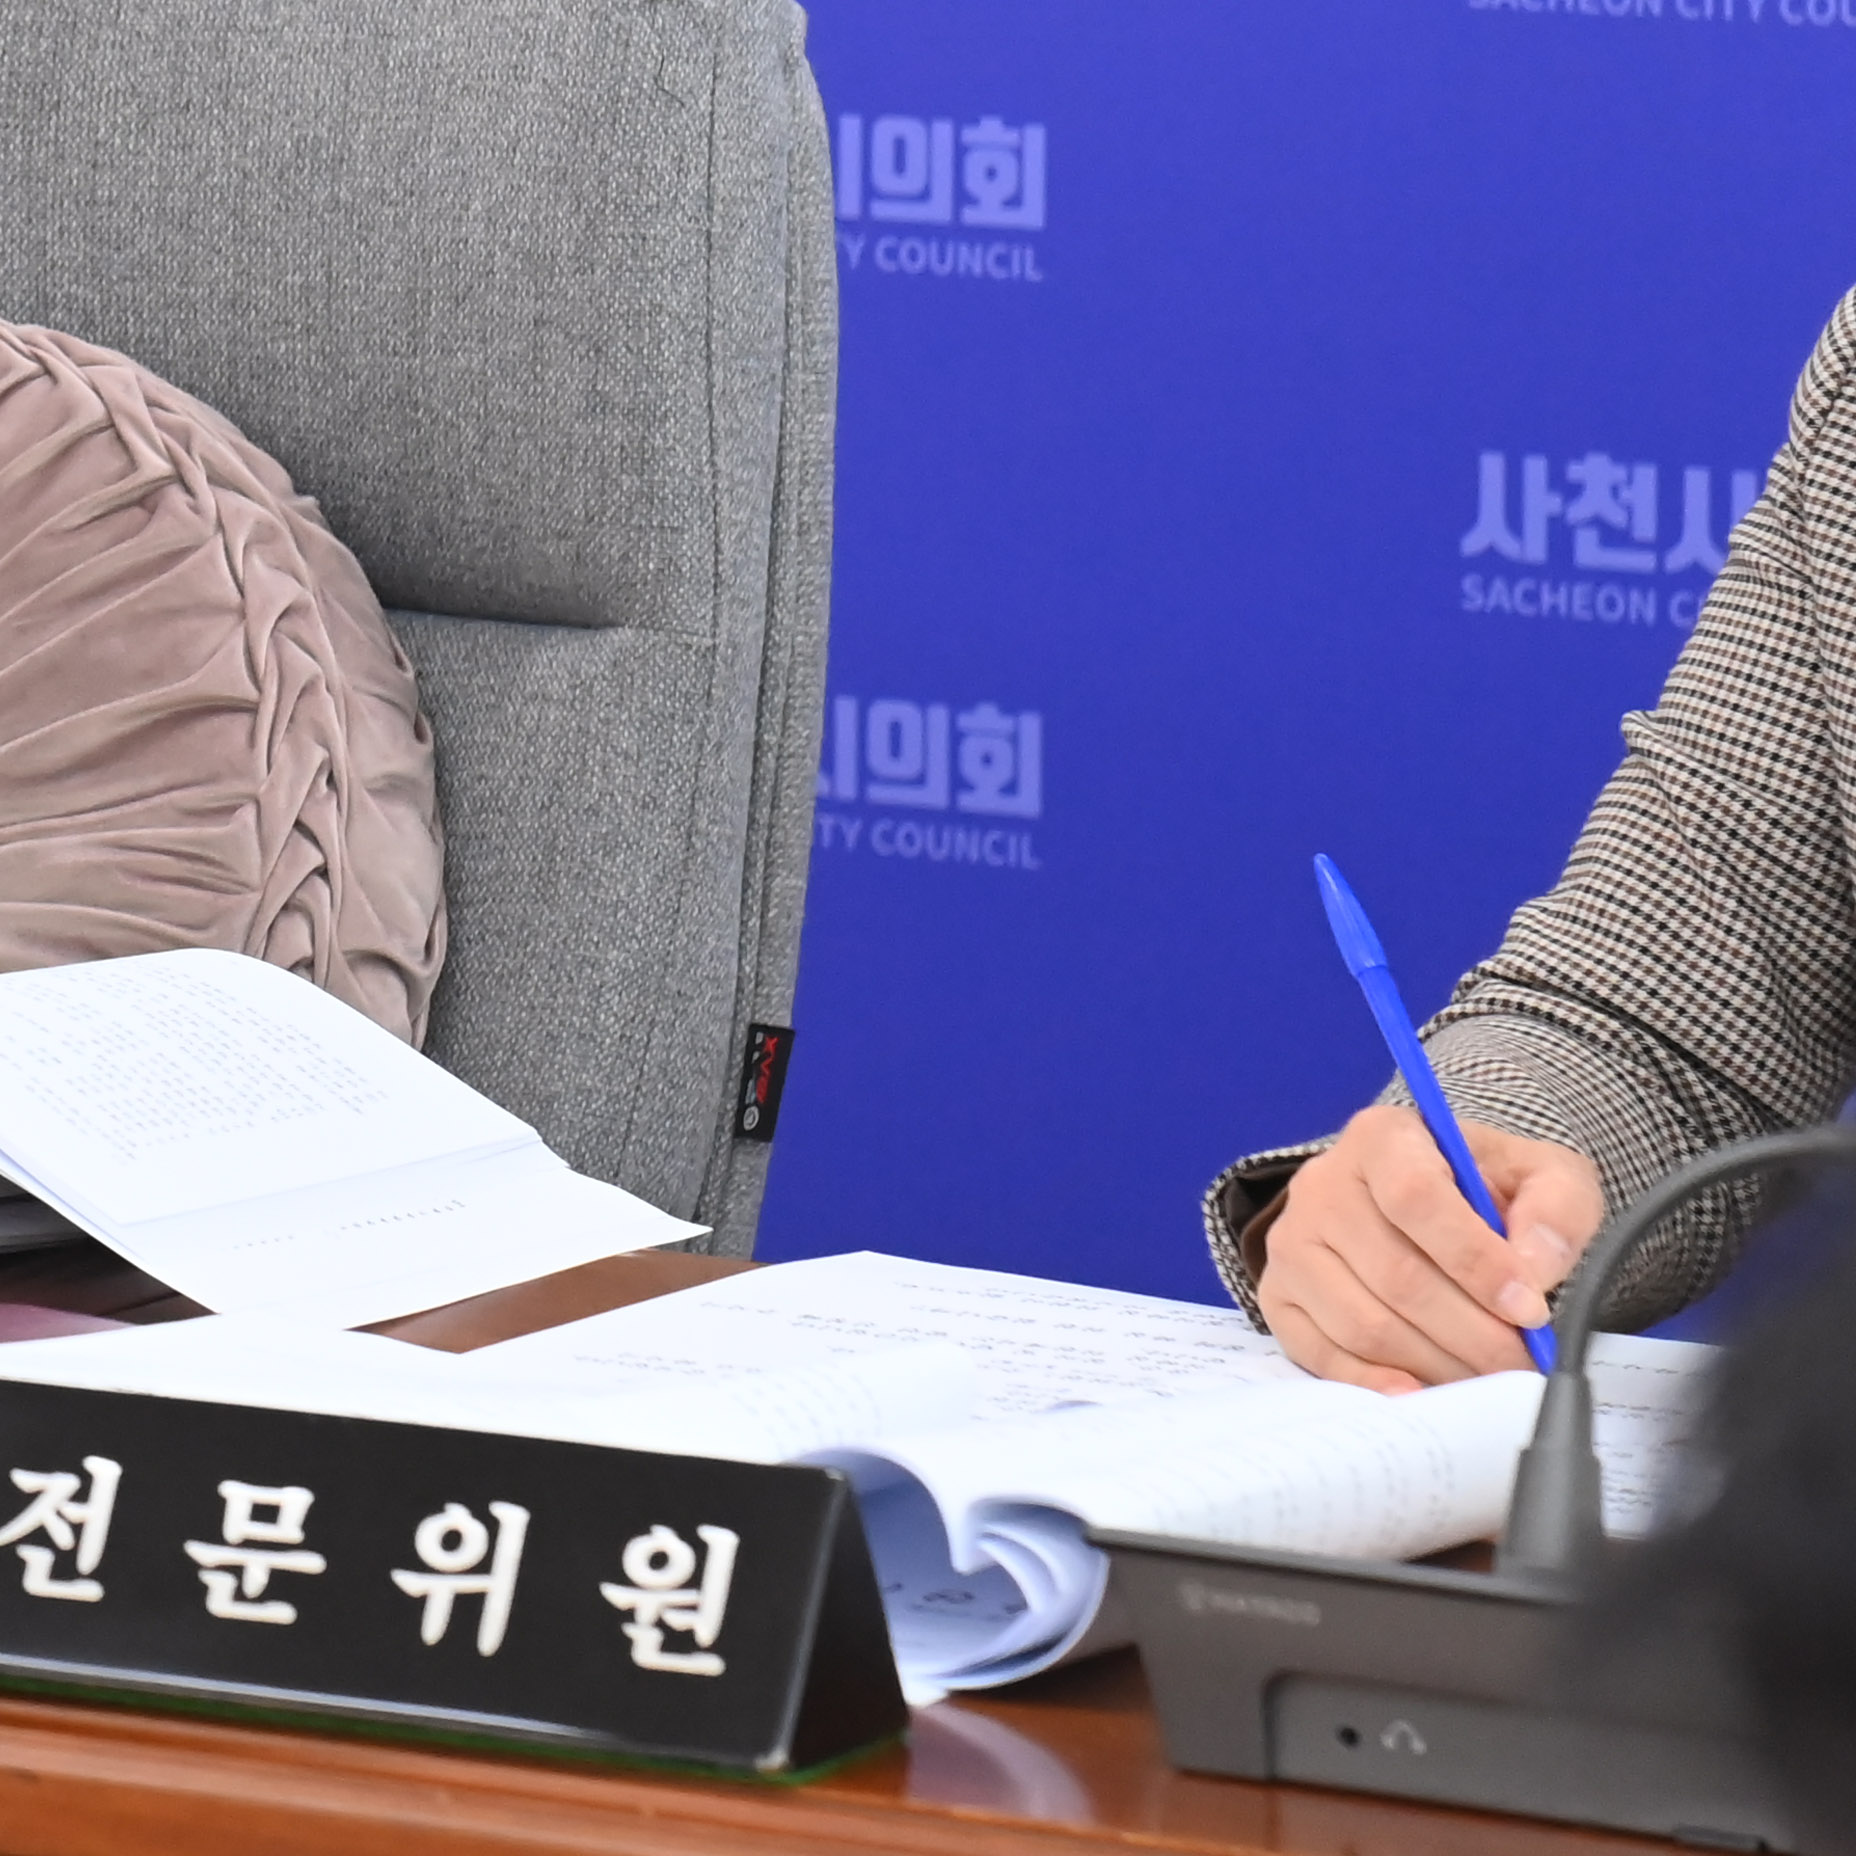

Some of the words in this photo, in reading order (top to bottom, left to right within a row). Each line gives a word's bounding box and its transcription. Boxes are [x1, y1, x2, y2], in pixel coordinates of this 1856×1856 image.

[874, 236, 1043, 282] COUNCIL
[1460, 575, 1657, 624] SACHEON
[870, 824, 1041, 870] COUNCIL
